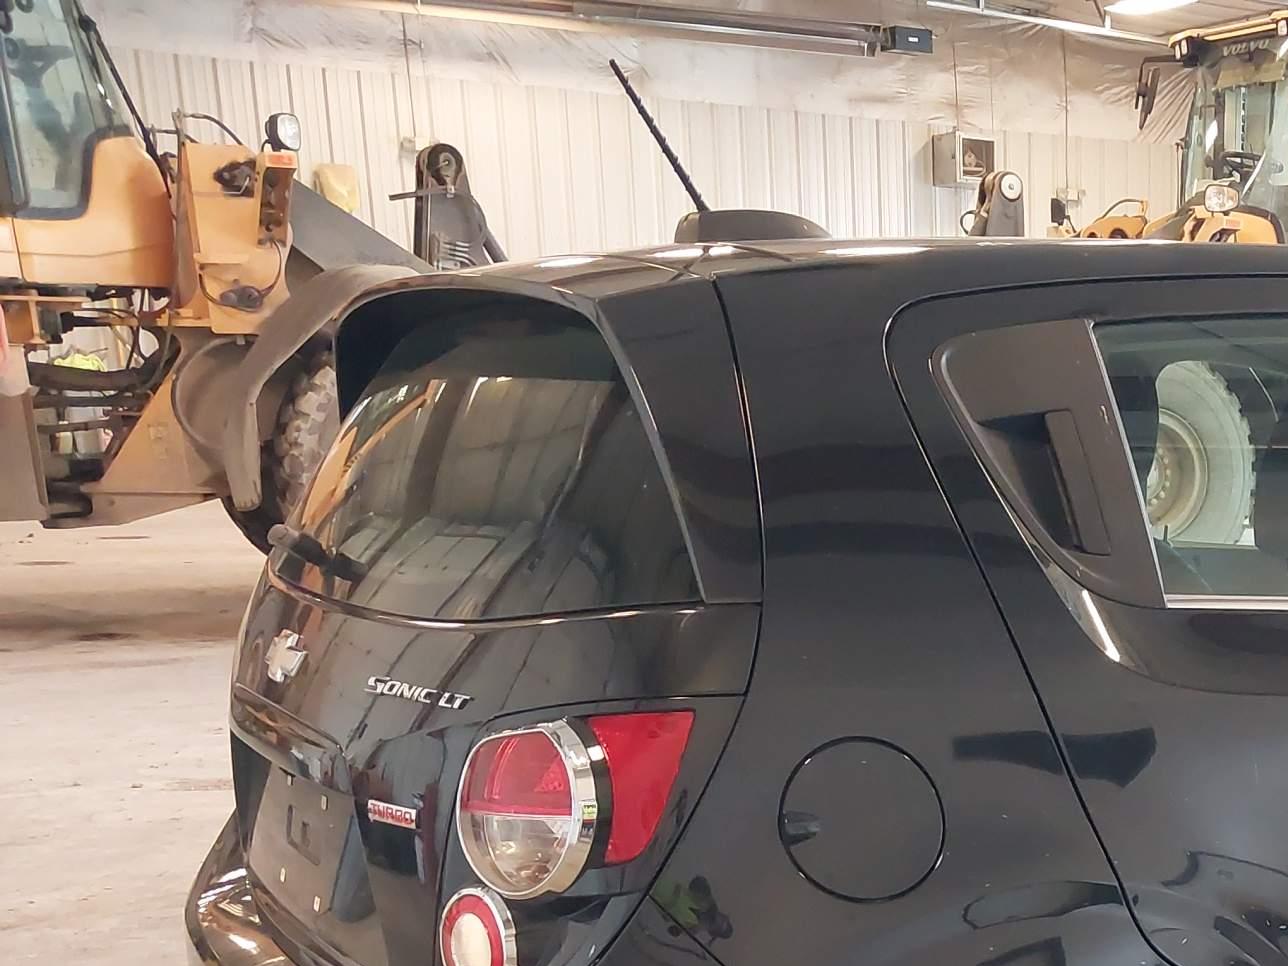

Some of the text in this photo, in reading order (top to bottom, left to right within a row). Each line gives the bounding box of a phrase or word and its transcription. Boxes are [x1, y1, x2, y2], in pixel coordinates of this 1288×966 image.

[1223, 39, 1269, 56] VOLVO
[438, 692, 472, 709] LT
[369, 802, 414, 825] TURBO
